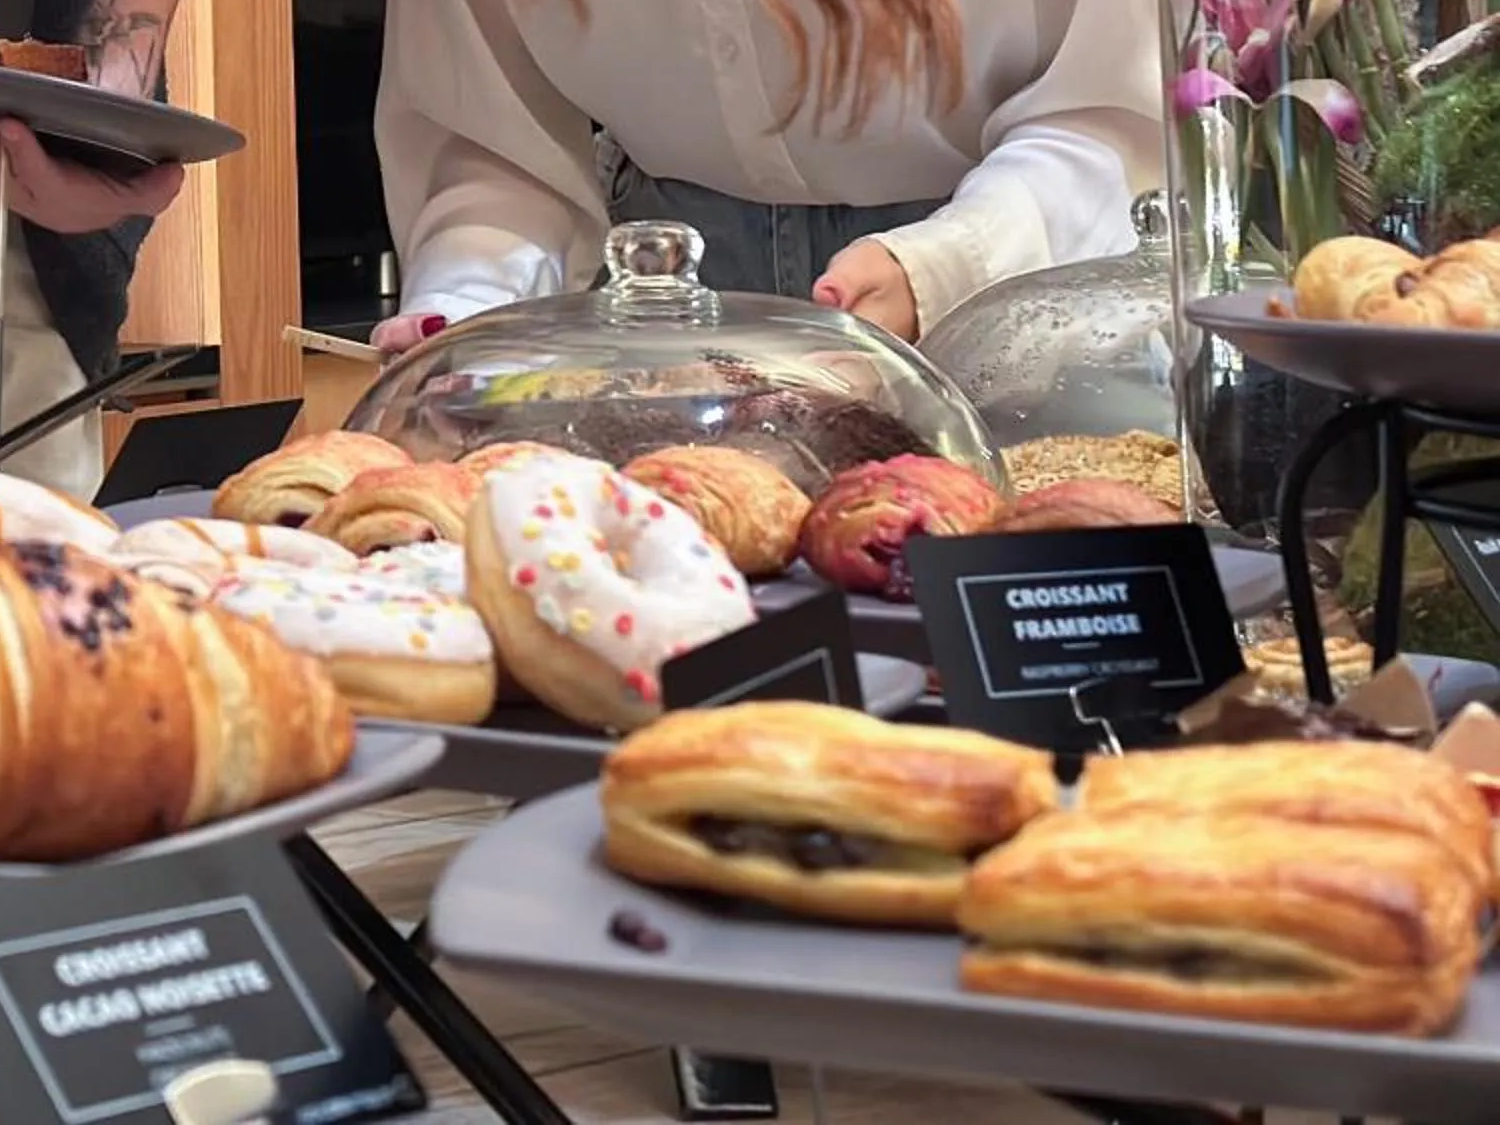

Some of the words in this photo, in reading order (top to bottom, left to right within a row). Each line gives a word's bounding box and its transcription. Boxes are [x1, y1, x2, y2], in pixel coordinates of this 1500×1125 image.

[1005, 582, 1129, 610] CROISSANT
[1013, 613, 1142, 641] FRAMBOISE
[53, 927, 211, 987] CROISSANT
[38, 987, 142, 1038] CACAO
[135, 959, 273, 1016] NOISETTE
